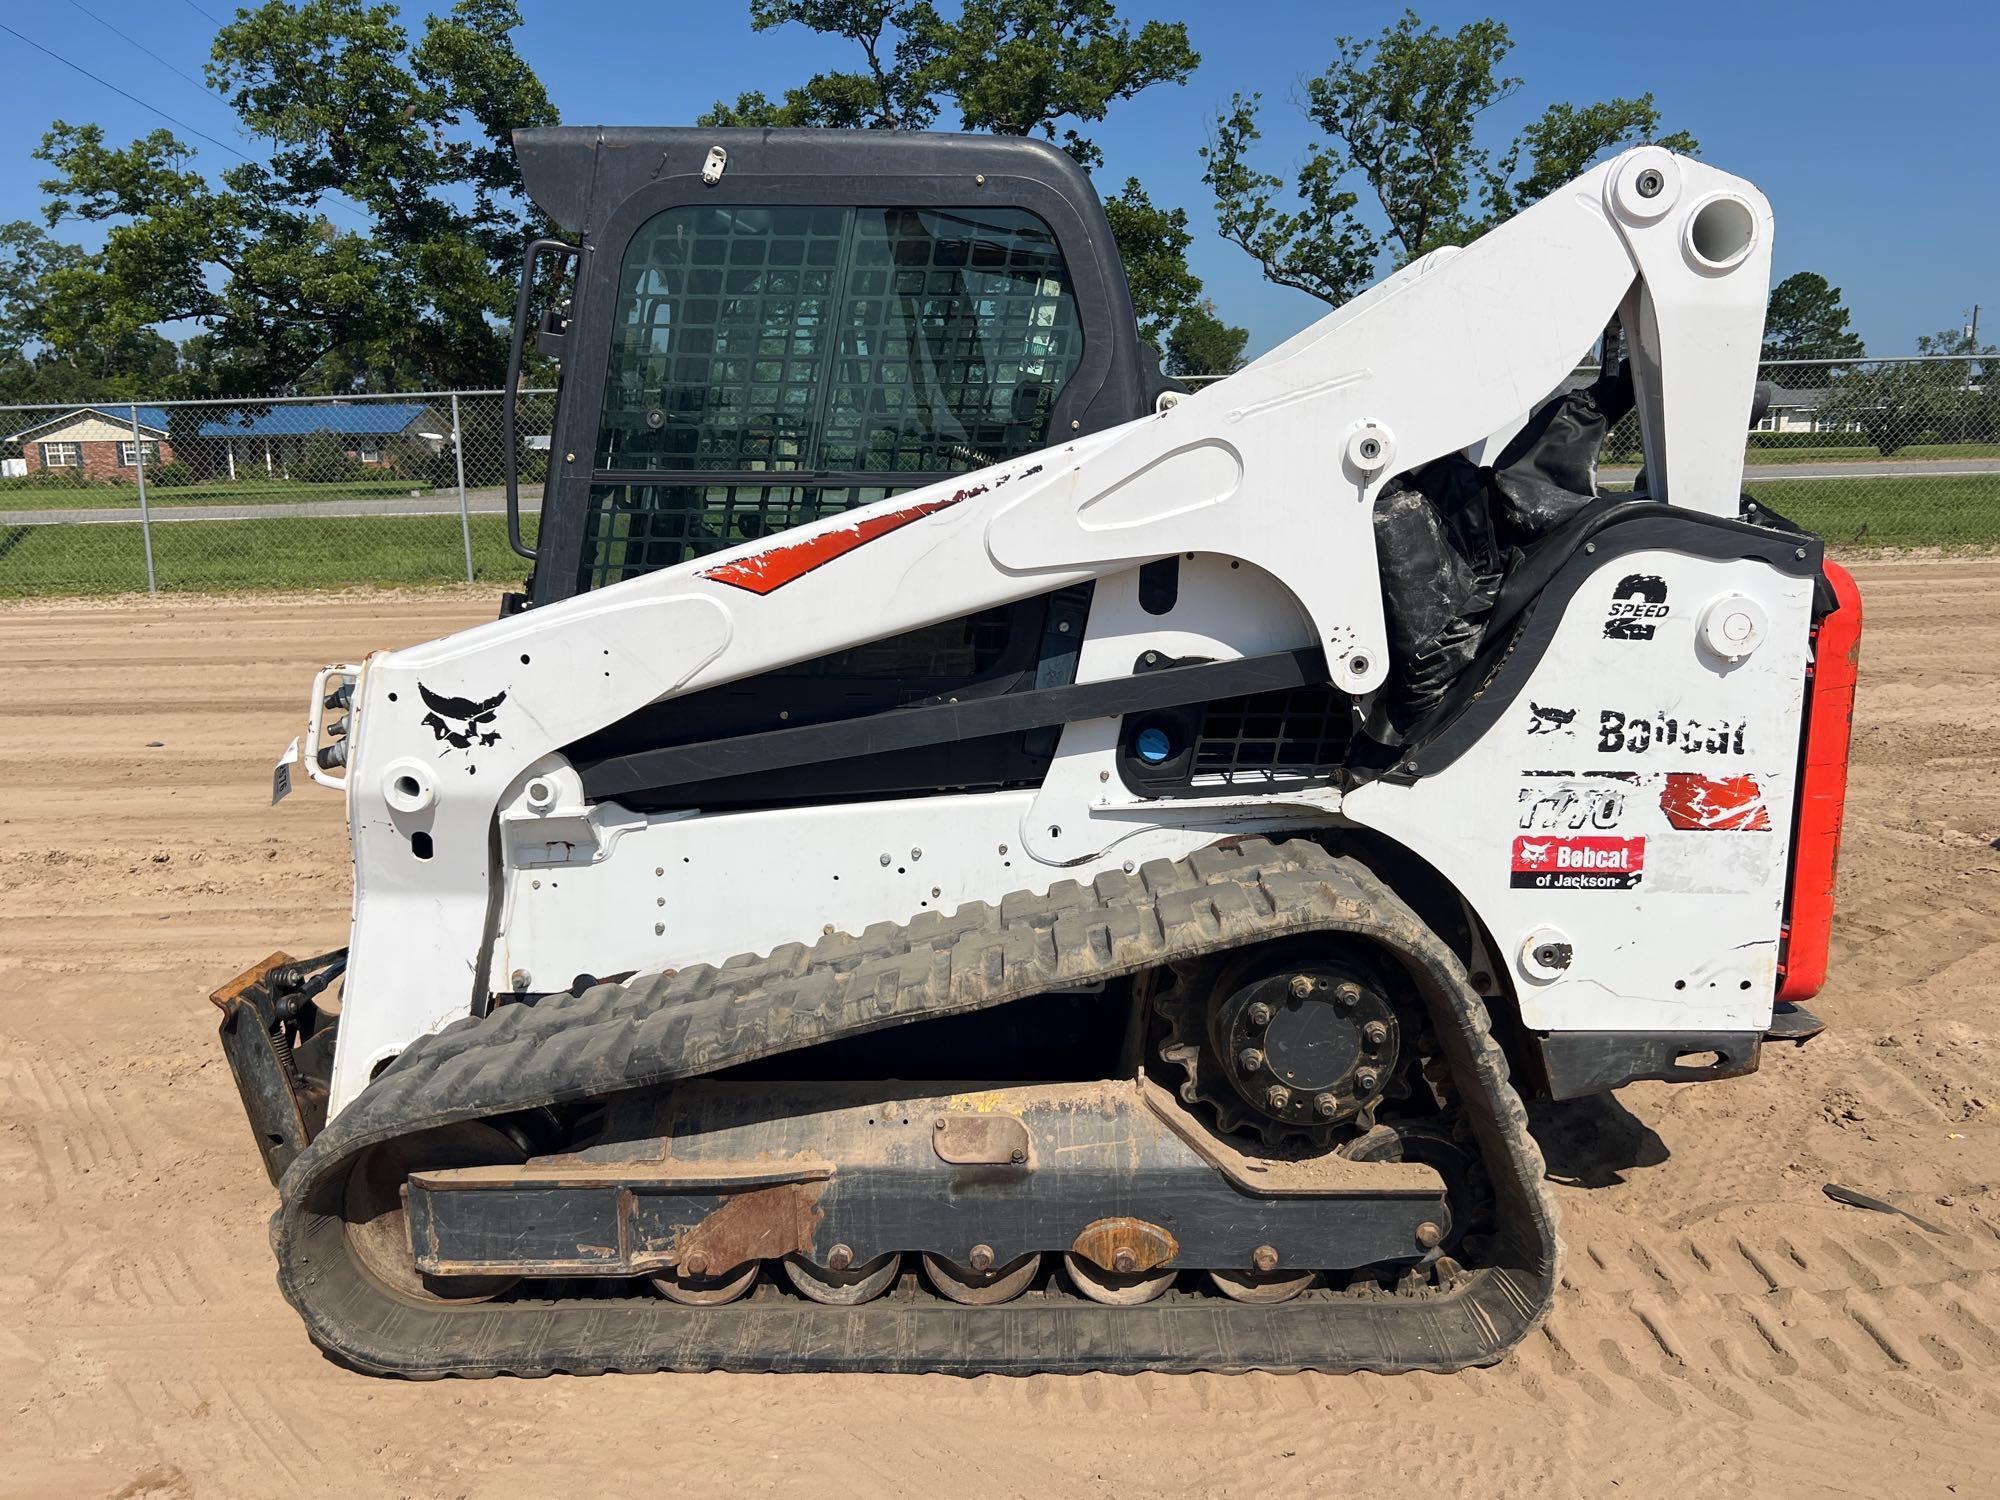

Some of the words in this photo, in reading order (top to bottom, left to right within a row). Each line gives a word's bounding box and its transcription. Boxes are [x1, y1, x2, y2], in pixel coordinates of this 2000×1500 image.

[1607, 603, 1670, 618] SPEED
[1556, 846, 1629, 869] Bobcat
[1535, 874, 1552, 887] of
[1554, 874, 1617, 888] Jackson
